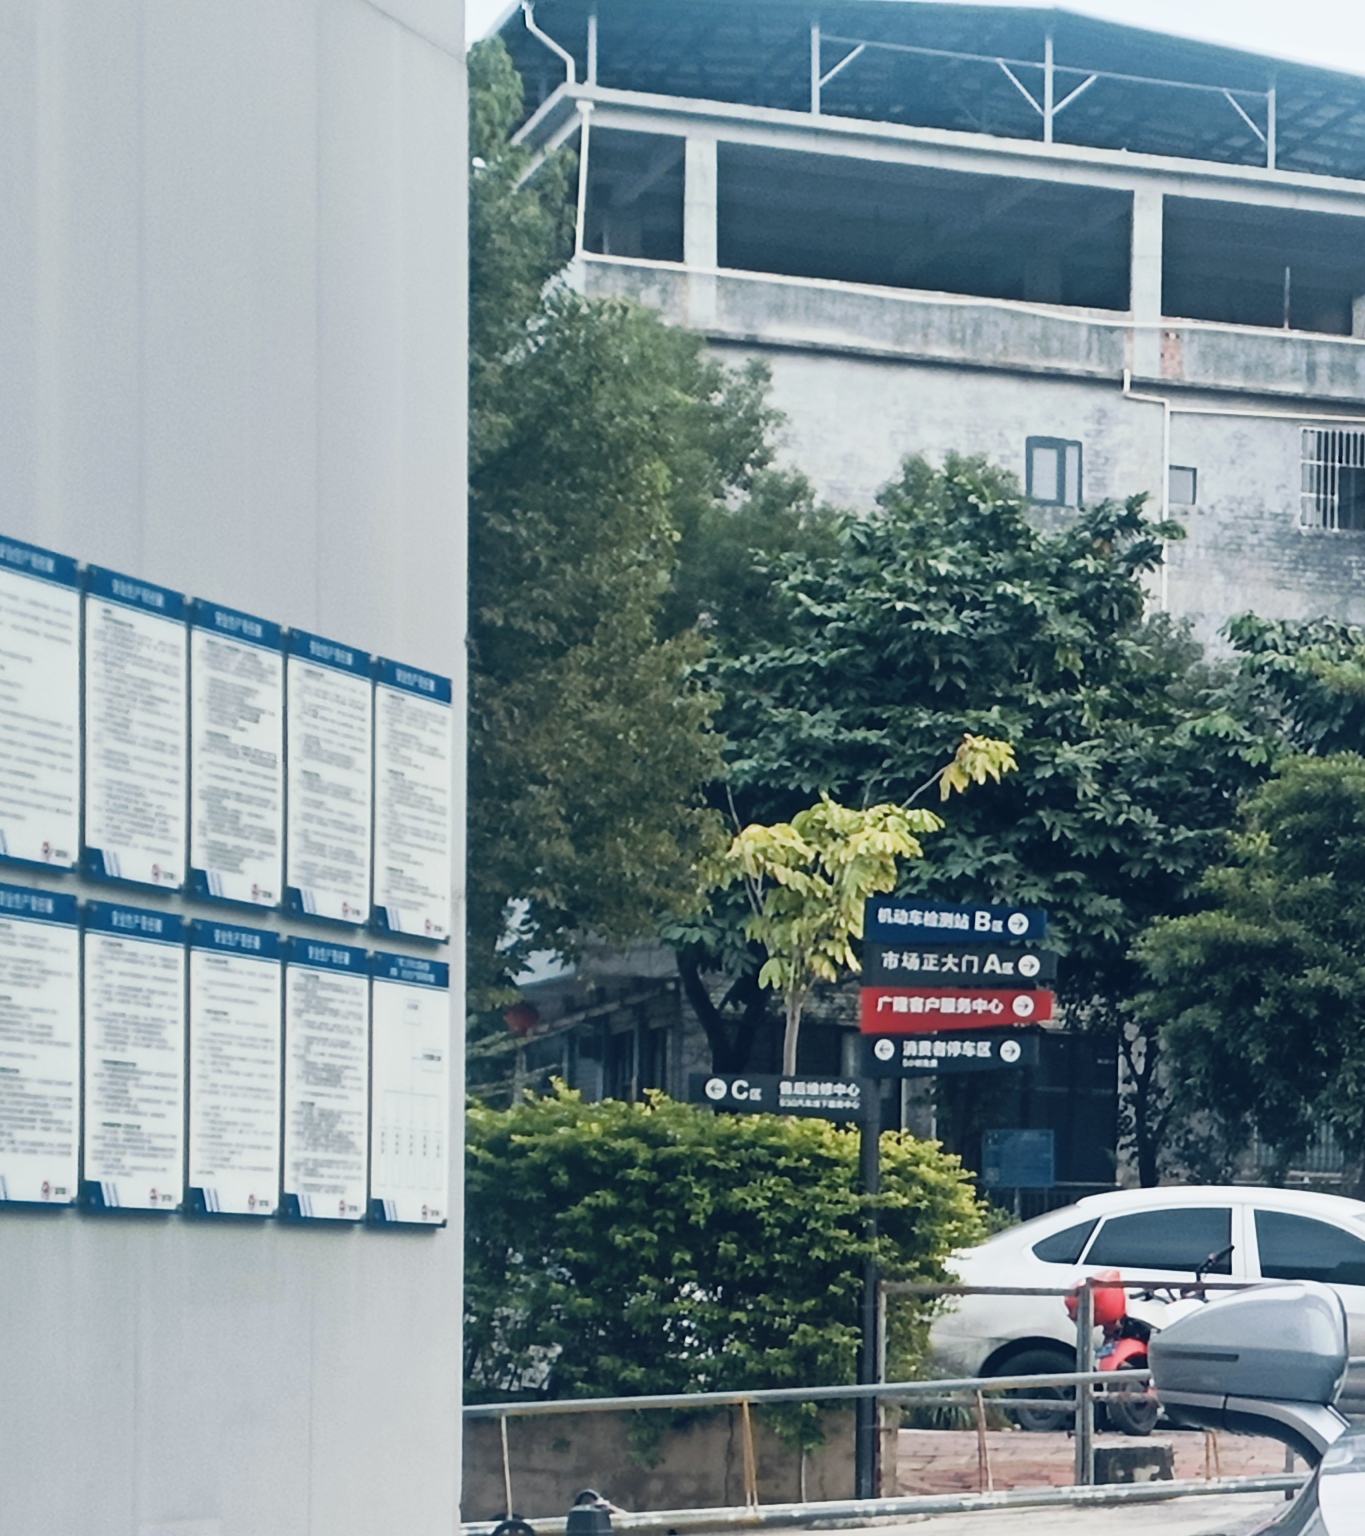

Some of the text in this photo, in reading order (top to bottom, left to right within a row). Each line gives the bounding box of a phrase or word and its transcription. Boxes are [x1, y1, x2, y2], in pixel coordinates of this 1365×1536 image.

[877, 907, 1003, 933] 机动车检测站 B区
[881, 951, 1014, 975] 市场正大门 A区
[902, 1040, 991, 1058] 消费者停车区
[731, 1079, 762, 1101] C区
